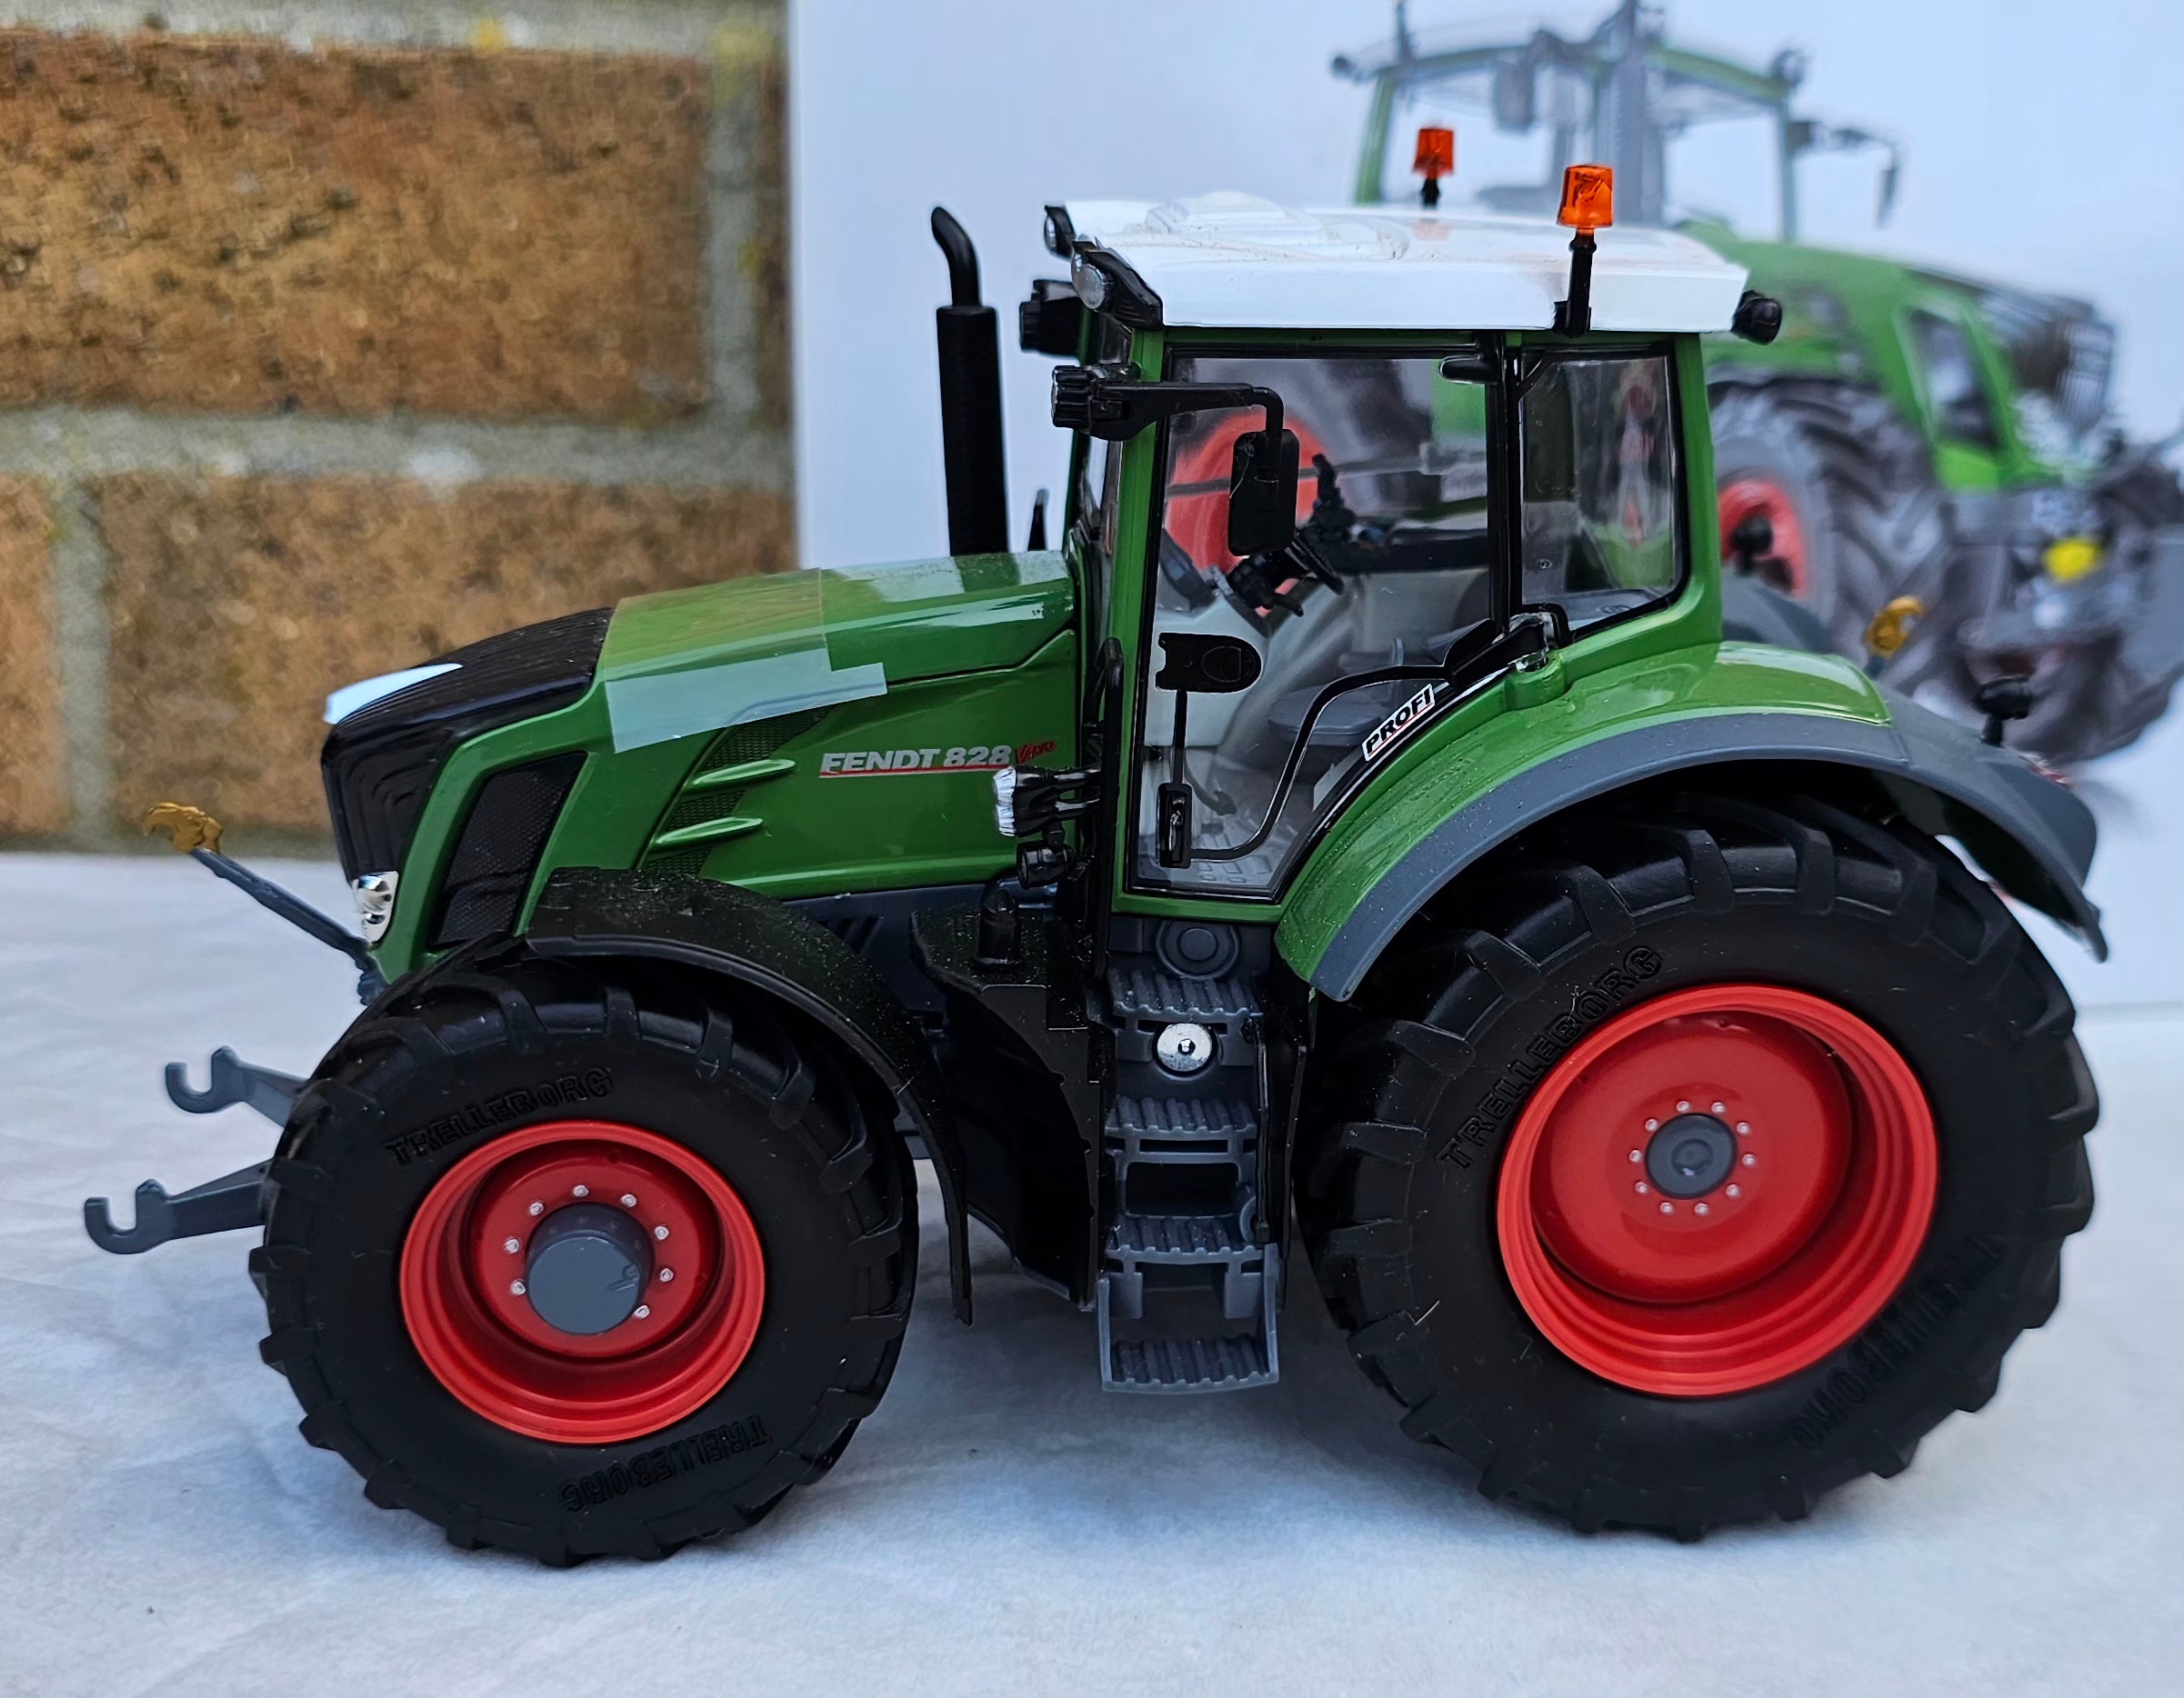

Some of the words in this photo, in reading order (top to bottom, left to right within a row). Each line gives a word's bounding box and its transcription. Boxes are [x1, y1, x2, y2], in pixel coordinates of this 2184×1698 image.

[820, 748, 941, 772] FENDT
[943, 744, 1012, 767] 828
[1365, 687, 1433, 755] PROFI
[1436, 944, 1663, 1170] TRELLEBORG
[385, 1066, 614, 1166] TRELLEBORG
[559, 1413, 773, 1513] TRELLEBORG
